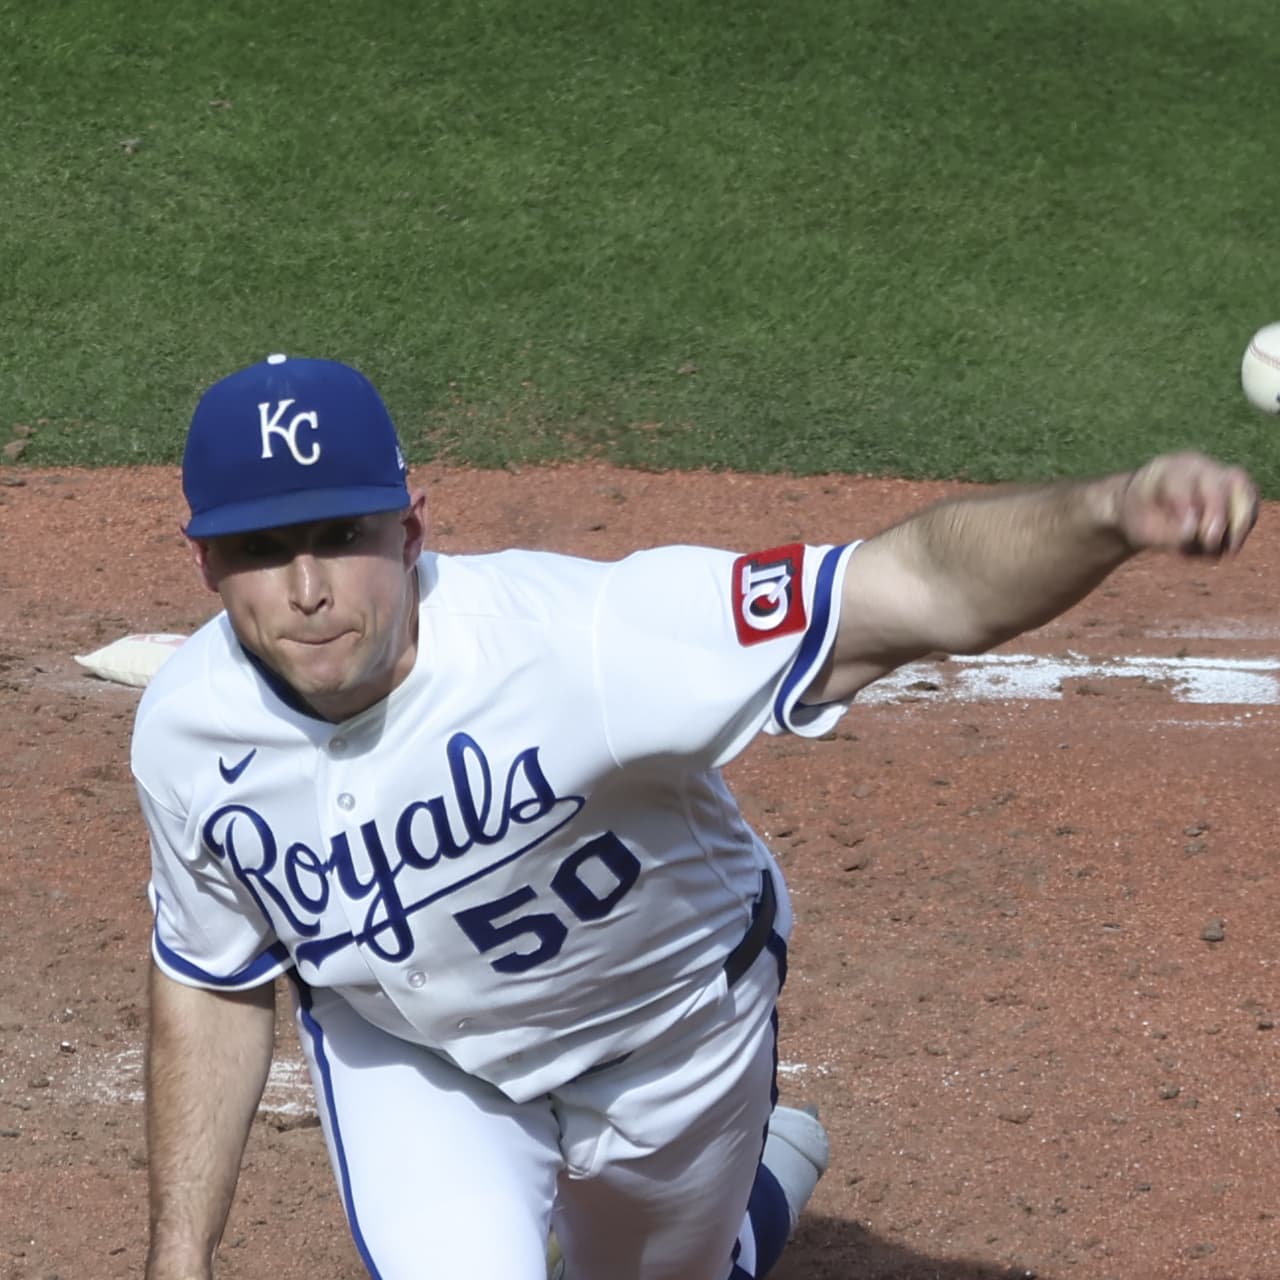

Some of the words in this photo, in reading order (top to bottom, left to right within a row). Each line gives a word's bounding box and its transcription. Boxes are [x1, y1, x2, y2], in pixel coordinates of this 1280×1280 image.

[258, 399, 320, 465] KC
[203, 732, 586, 966] Royals
[452, 830, 642, 973] 50
